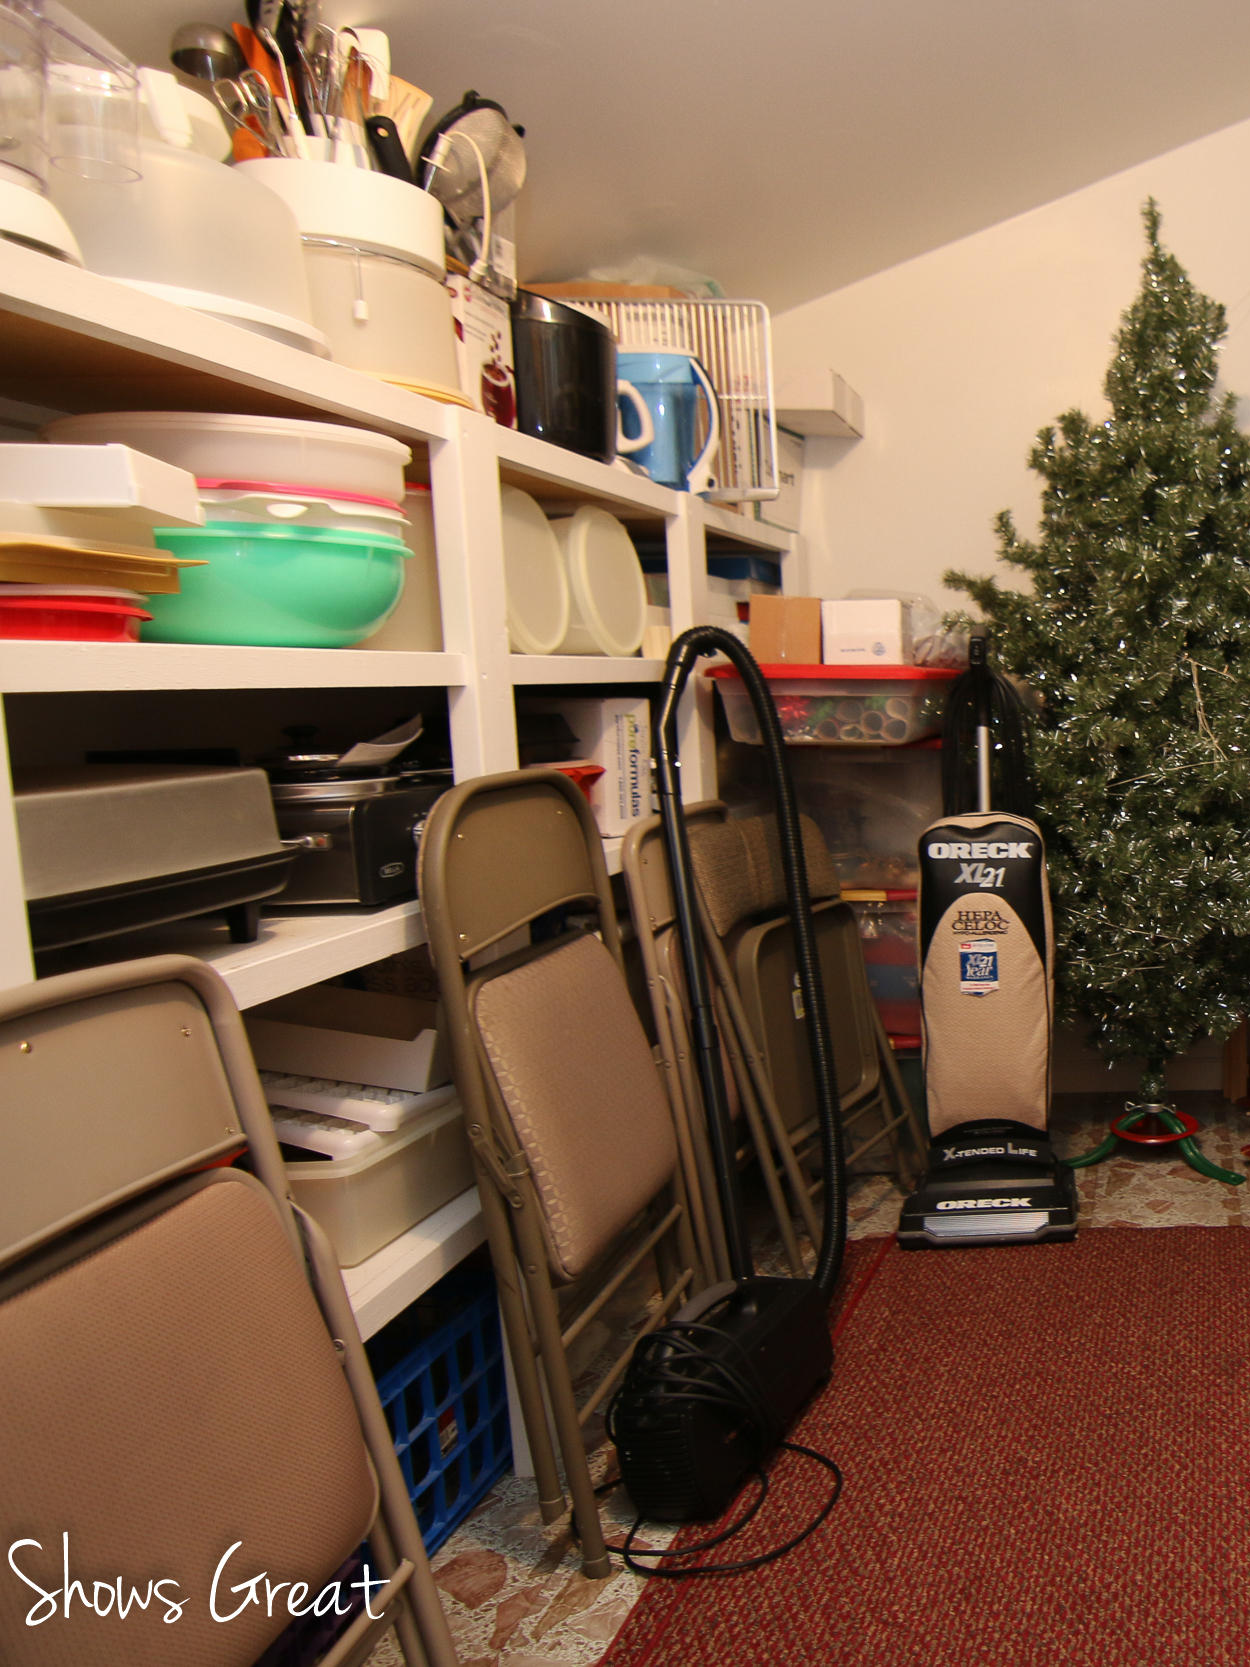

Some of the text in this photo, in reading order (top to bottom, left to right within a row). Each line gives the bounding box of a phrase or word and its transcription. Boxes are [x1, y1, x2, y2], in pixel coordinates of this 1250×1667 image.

[928, 842, 1034, 859] ORECK
[954, 862, 1006, 887] XL21
[954, 910, 1010, 923] HEPA
[951, 920, 1009, 931] CELOC
[936, 1197, 1033, 1210] ORECK
